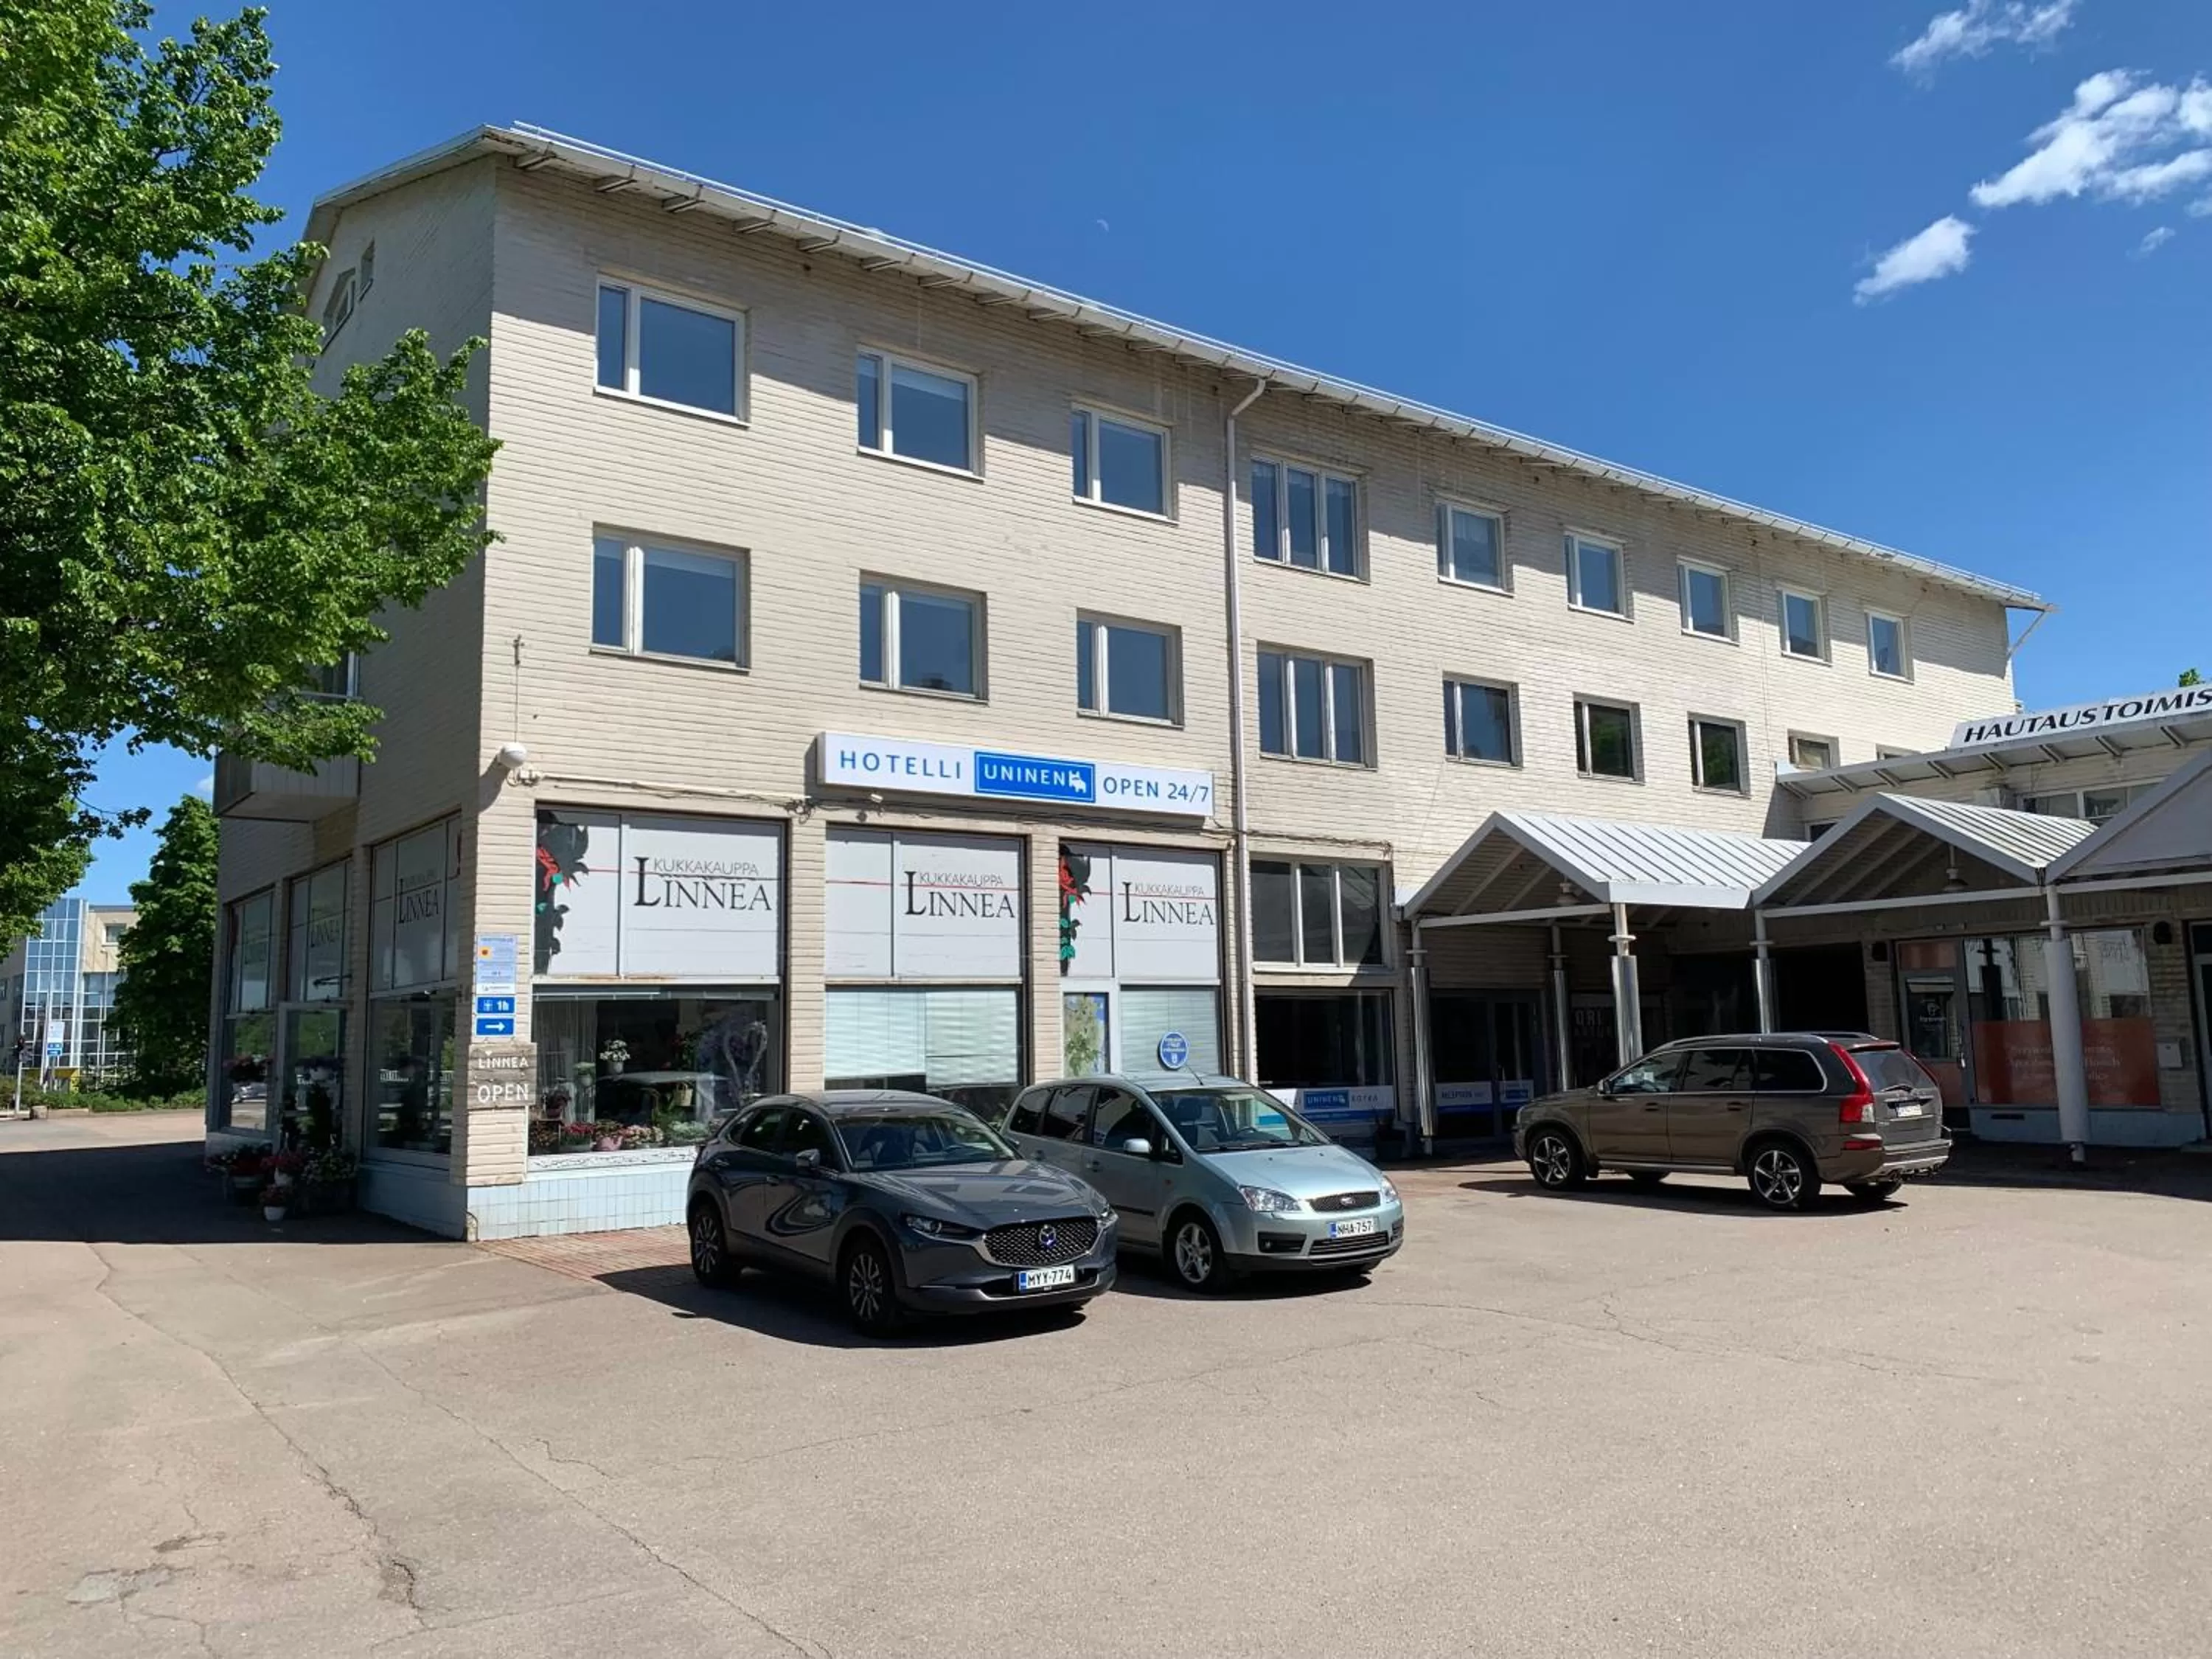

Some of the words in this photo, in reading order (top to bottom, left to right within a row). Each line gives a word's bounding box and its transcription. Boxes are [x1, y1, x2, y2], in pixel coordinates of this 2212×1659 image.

[839, 750, 961, 779] HOTELLI
[984, 762, 1068, 787] UNINEN
[1102, 776, 1160, 798] OPEN
[1167, 782, 1209, 804] 24/7
[653, 858, 759, 876] KUKKAKAUPPA
[919, 872, 1004, 886] KUKKAKAUPPA
[633, 856, 772, 911] LINNEA
[904, 871, 1015, 918] LINNEA
[398, 878, 439, 923] LINNEA
[1122, 881, 1215, 925] LINNEA
[478, 1057, 529, 1068] LINNEA
[478, 1082, 529, 1103] OPEN
[1028, 1268, 1071, 1286] MYY-774
